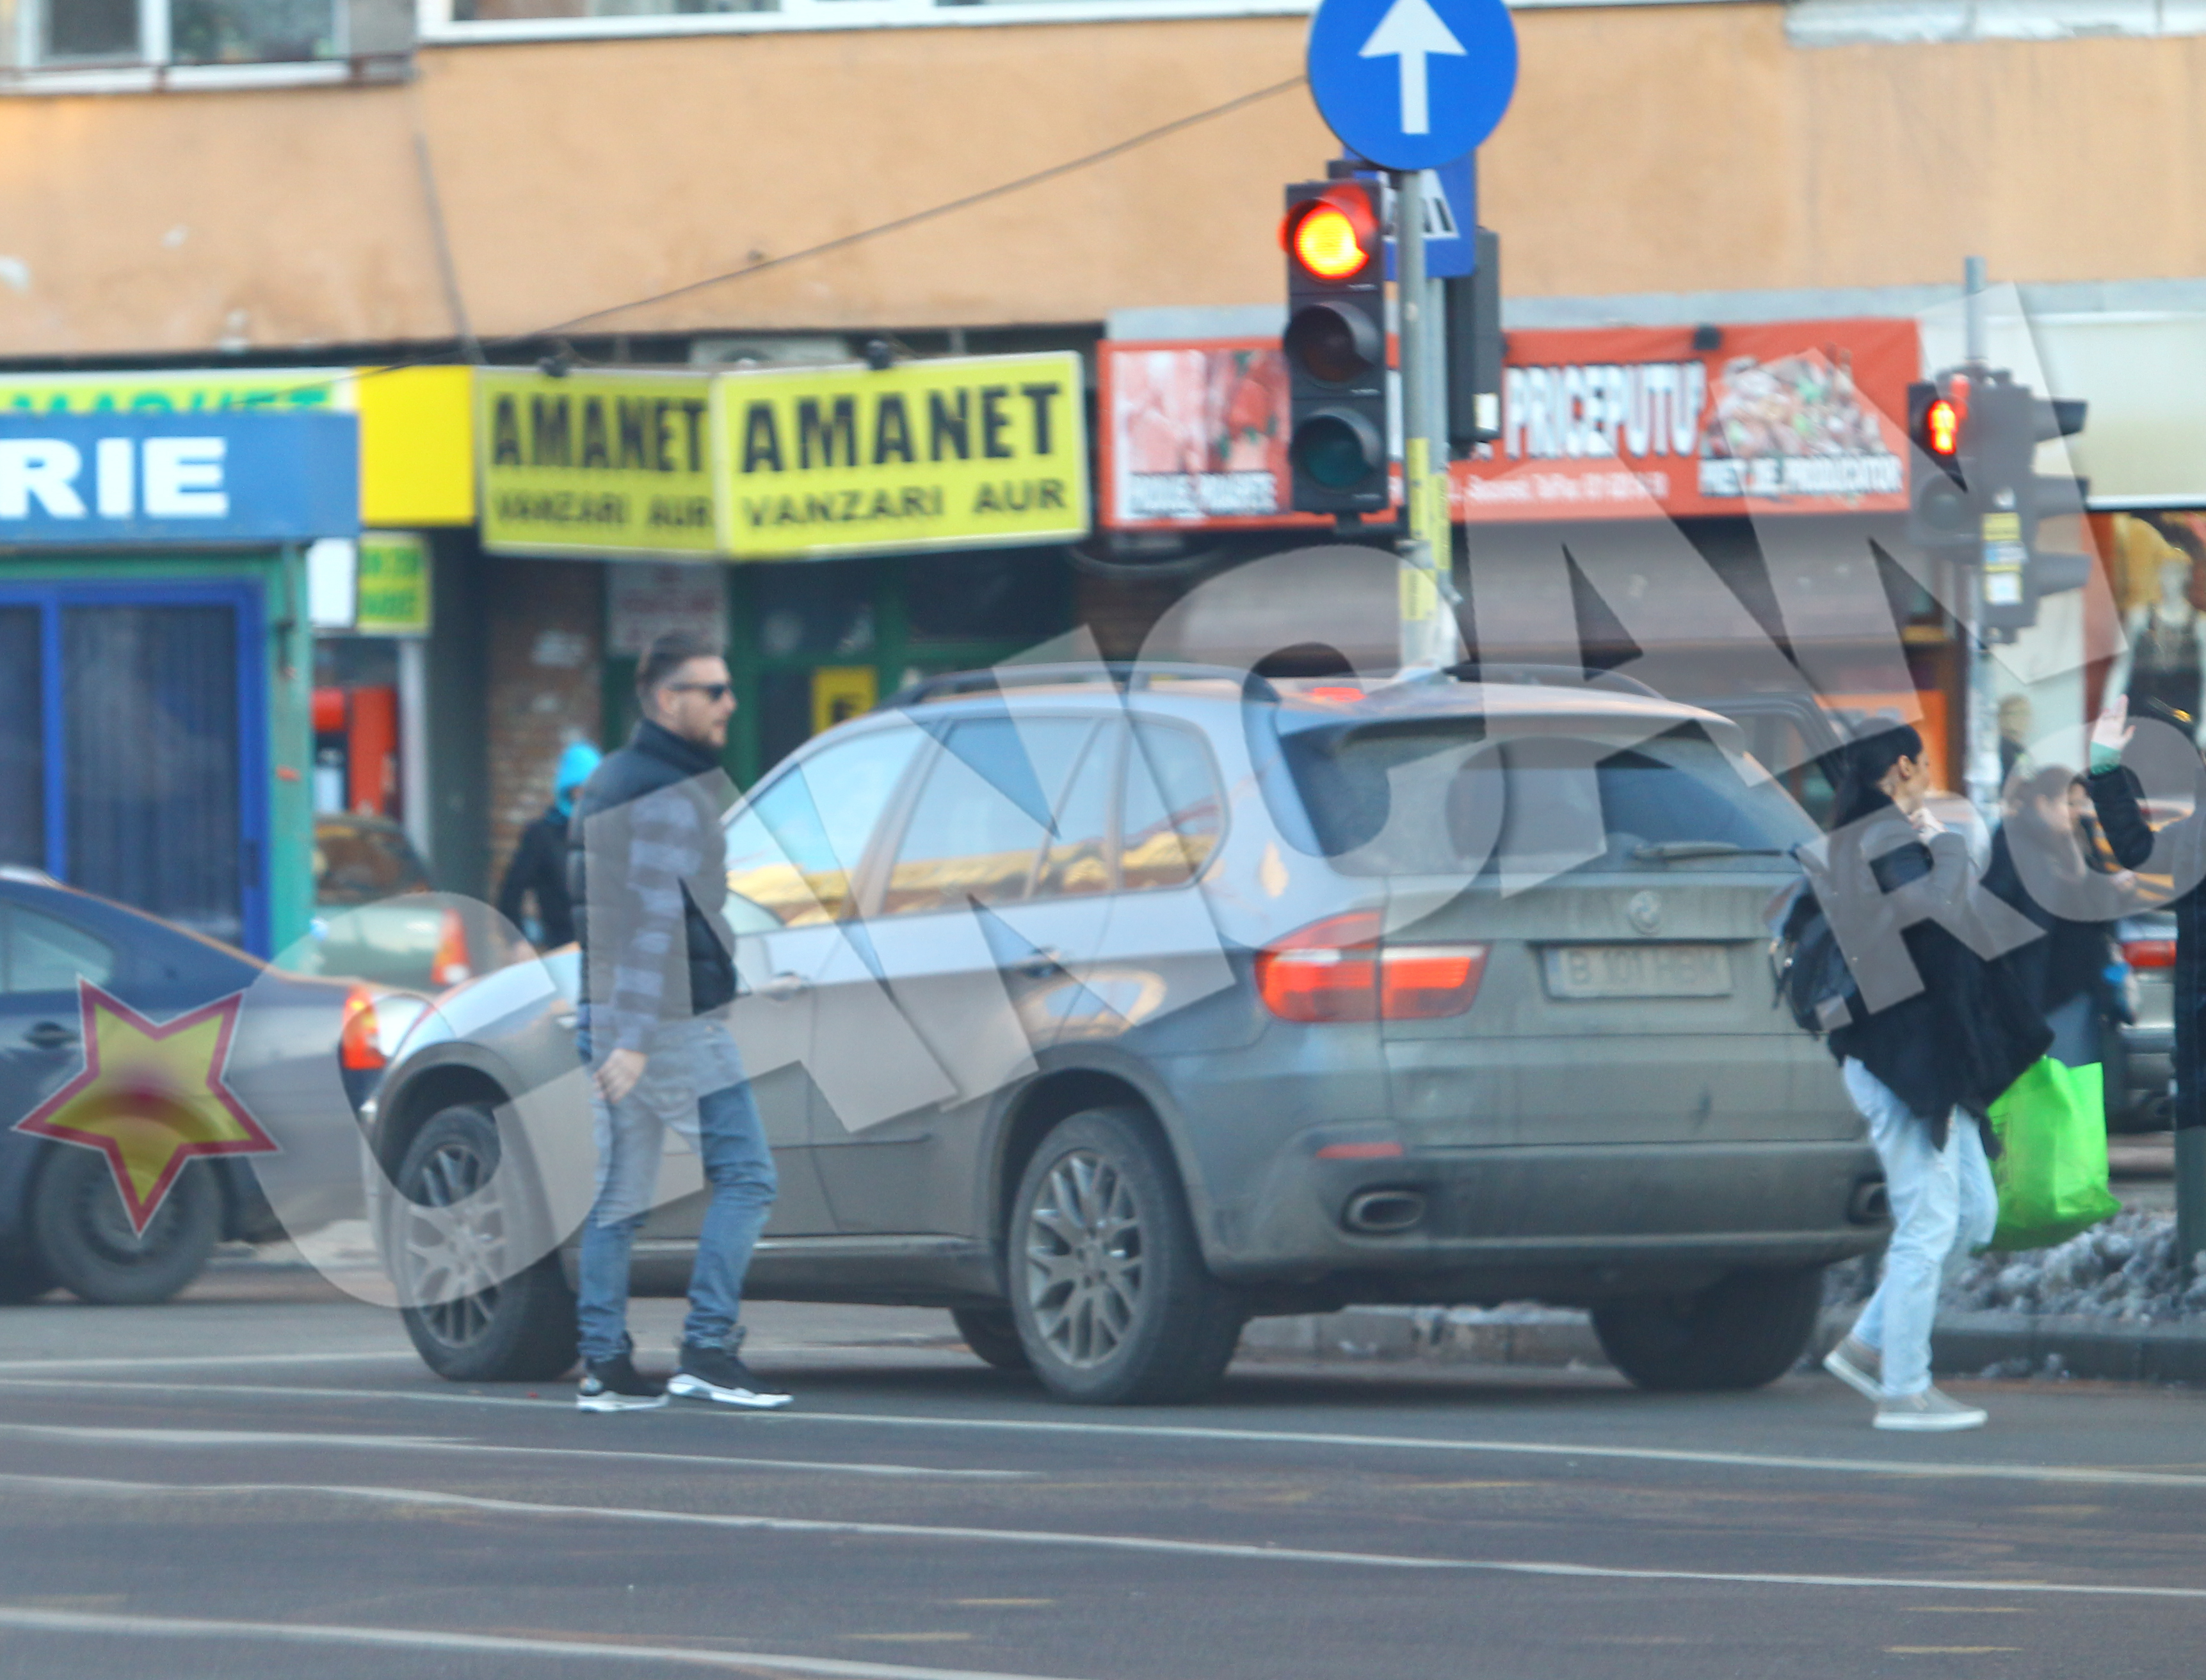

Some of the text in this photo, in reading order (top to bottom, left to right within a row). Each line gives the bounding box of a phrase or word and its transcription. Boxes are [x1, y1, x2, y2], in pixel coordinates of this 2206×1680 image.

[493, 392, 708, 472] AMANET
[741, 382, 1060, 474] AMANET
[0, 437, 229, 518] RIE
[648, 494, 714, 528] AUR
[741, 478, 1066, 526] VANZARI AUR
